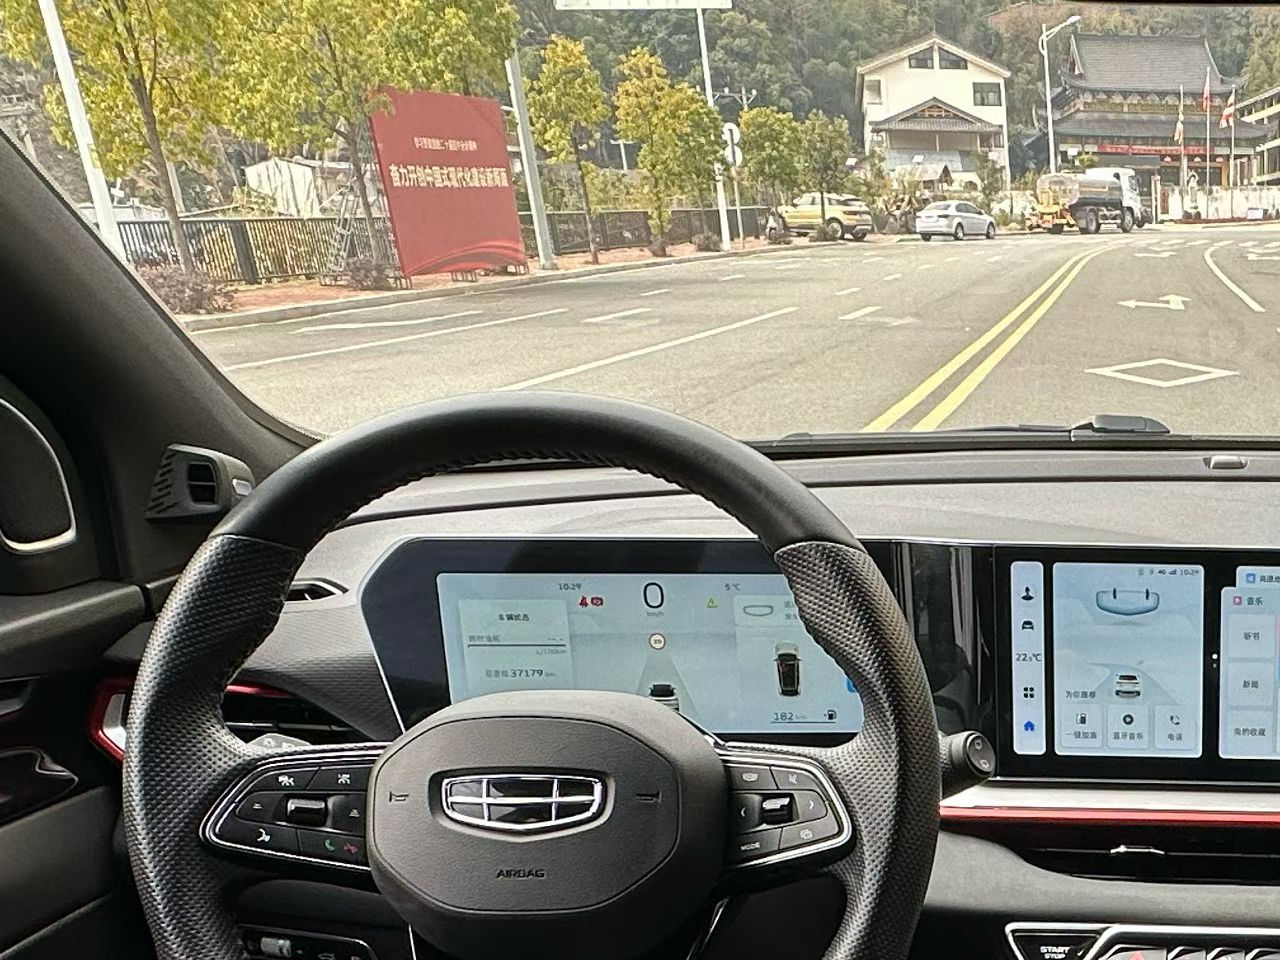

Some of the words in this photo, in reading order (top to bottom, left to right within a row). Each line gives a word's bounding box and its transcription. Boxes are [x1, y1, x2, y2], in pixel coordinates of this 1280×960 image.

[643, 582, 665, 608] 0
[1247, 597, 1263, 606] 音乐
[510, 669, 544, 678] 37179
[1113, 731, 1144, 740] 蓝牙音乐
[1167, 733, 1183, 741] 电话
[496, 868, 545, 878] AIRBAG
[1040, 946, 1070, 954] START
